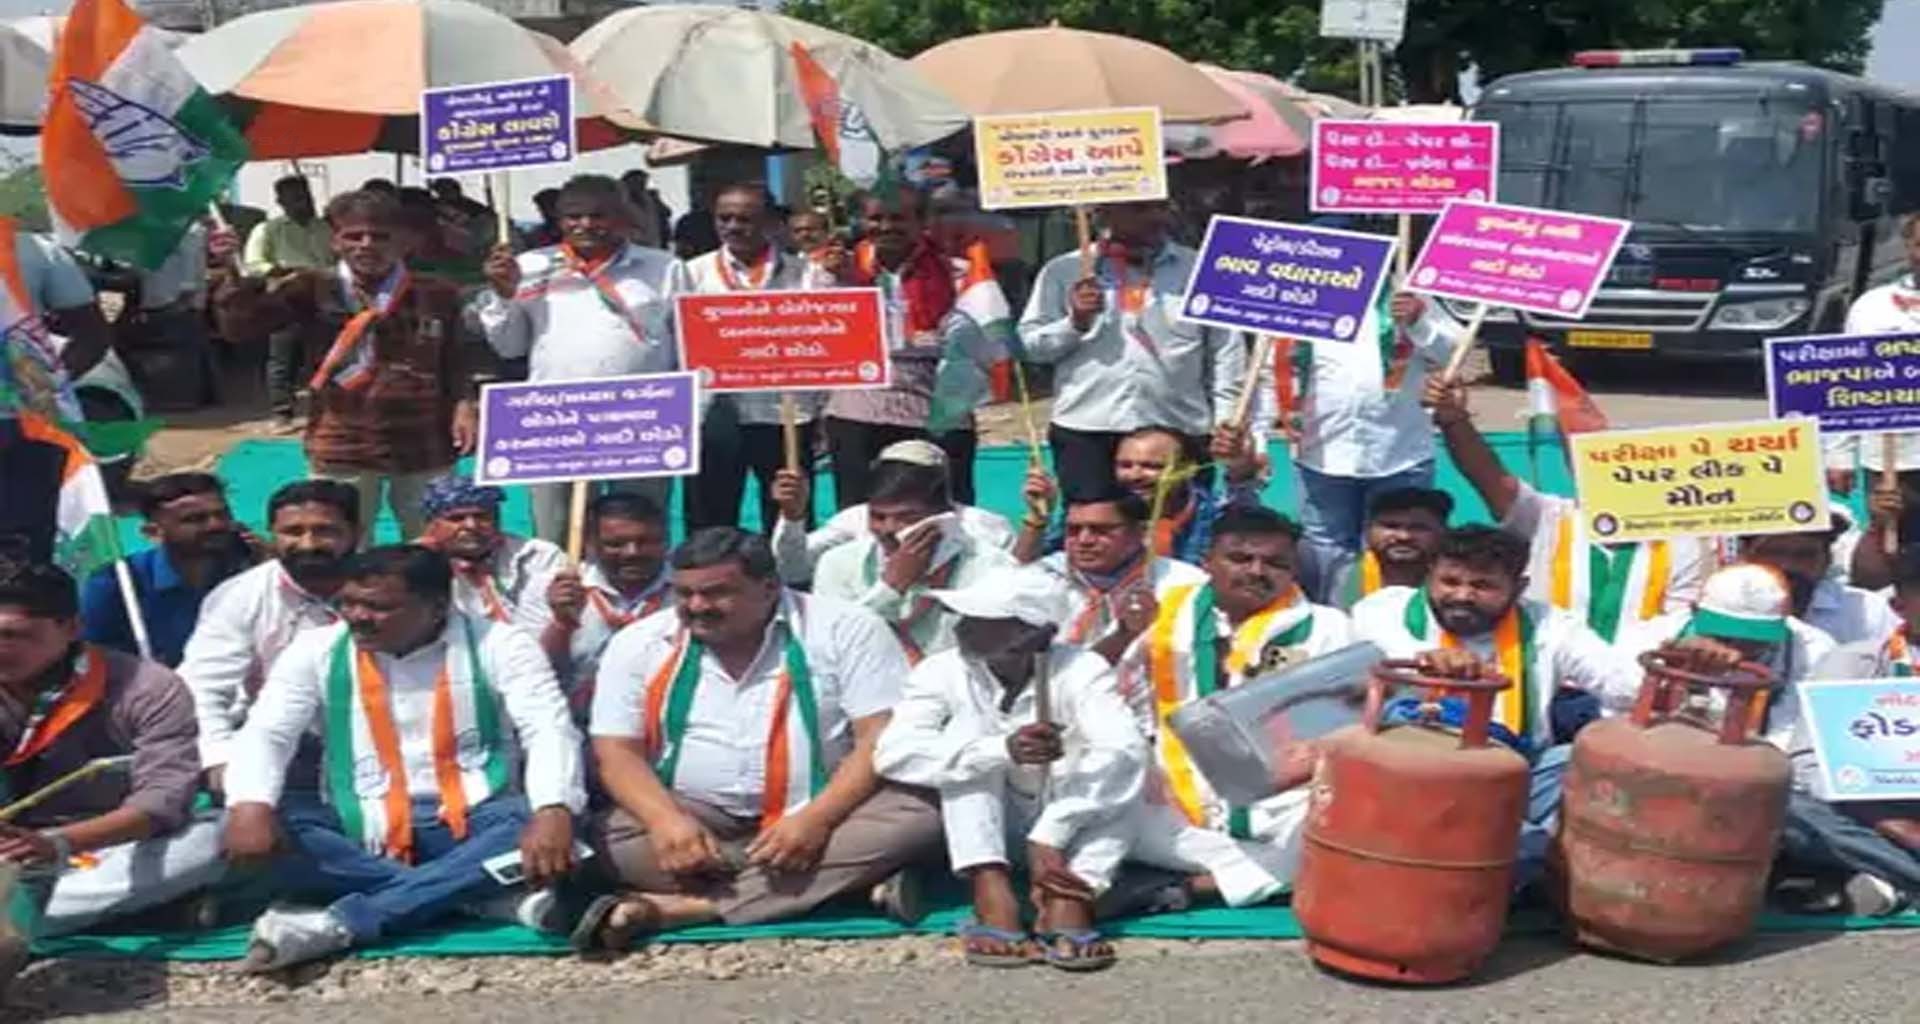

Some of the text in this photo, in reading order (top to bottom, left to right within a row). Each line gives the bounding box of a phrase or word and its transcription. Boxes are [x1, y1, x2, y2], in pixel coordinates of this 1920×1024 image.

[1215, 256, 1260, 275] ભાવ
[1589, 428, 1800, 463] પરીક્ષા પે ચર્ચા
[1612, 456, 1783, 484] પેપર લીક પે
[1666, 484, 1735, 506] મૌન
